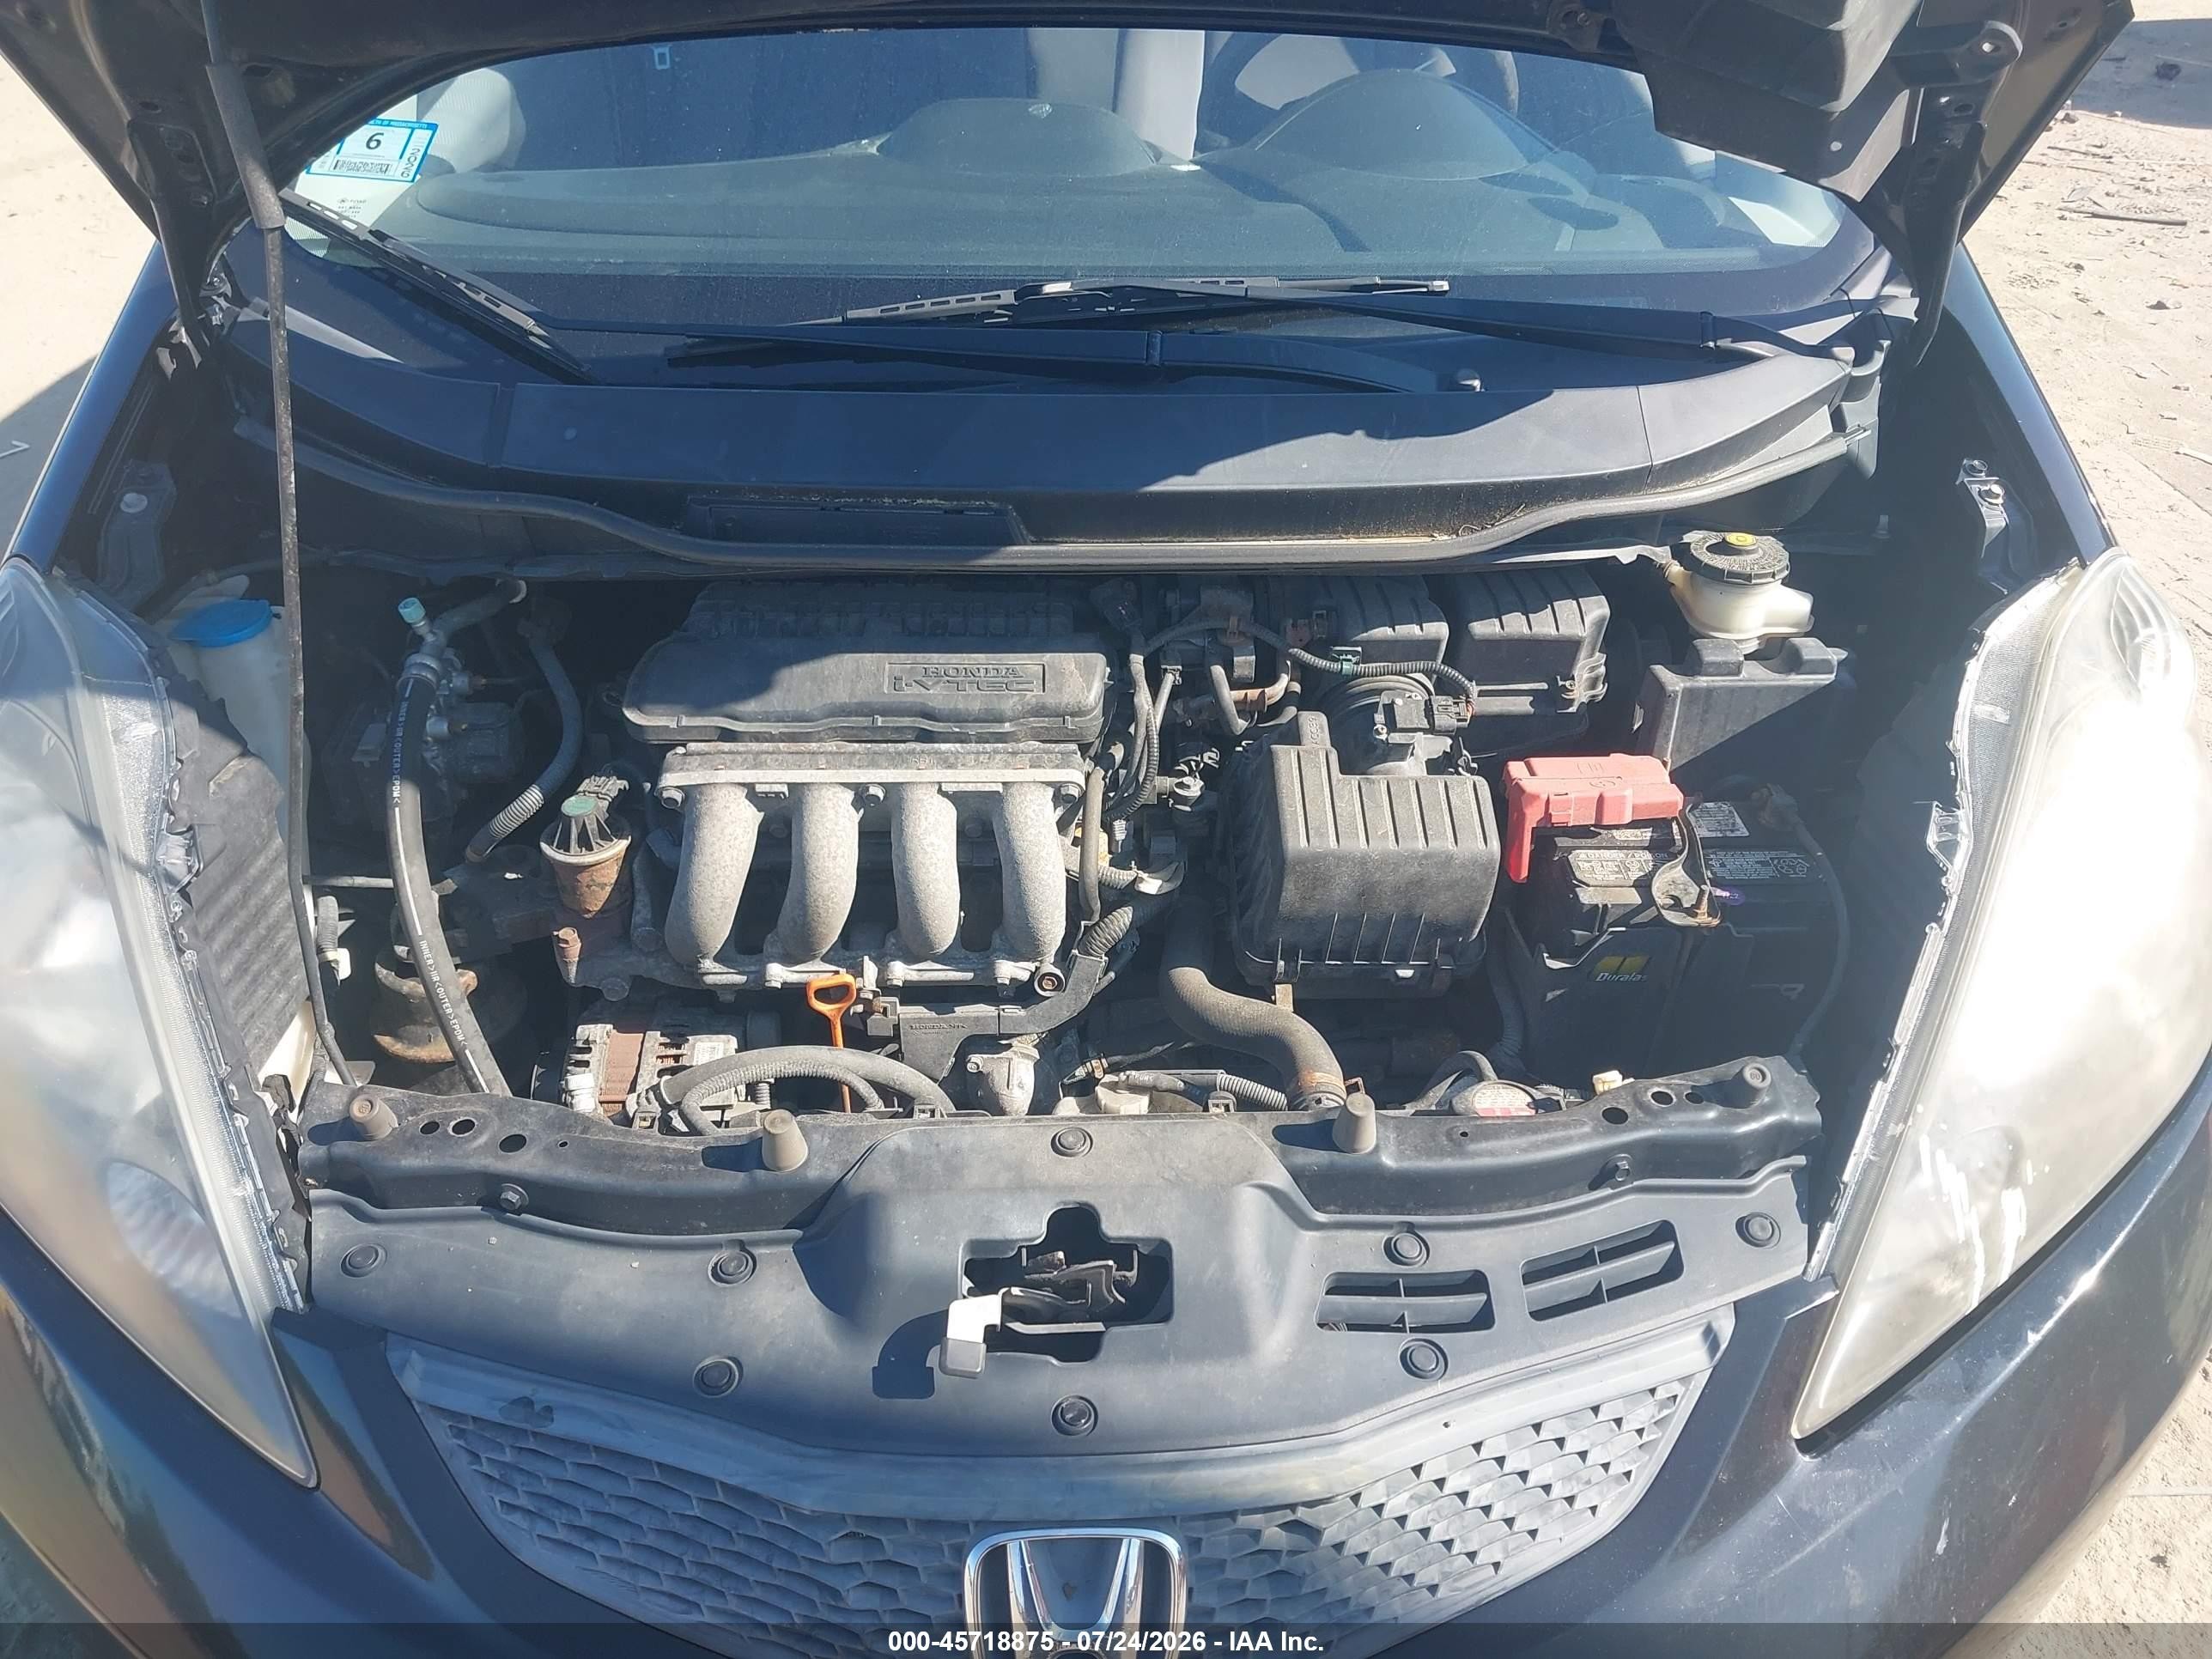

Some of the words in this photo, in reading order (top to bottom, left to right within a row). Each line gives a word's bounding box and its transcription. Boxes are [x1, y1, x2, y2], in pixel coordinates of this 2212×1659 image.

[365, 132, 385, 150] 6
[401, 148, 421, 179] 2026
[922, 666, 1024, 678] HONDA
[893, 675, 1035, 692] i-VTEC
